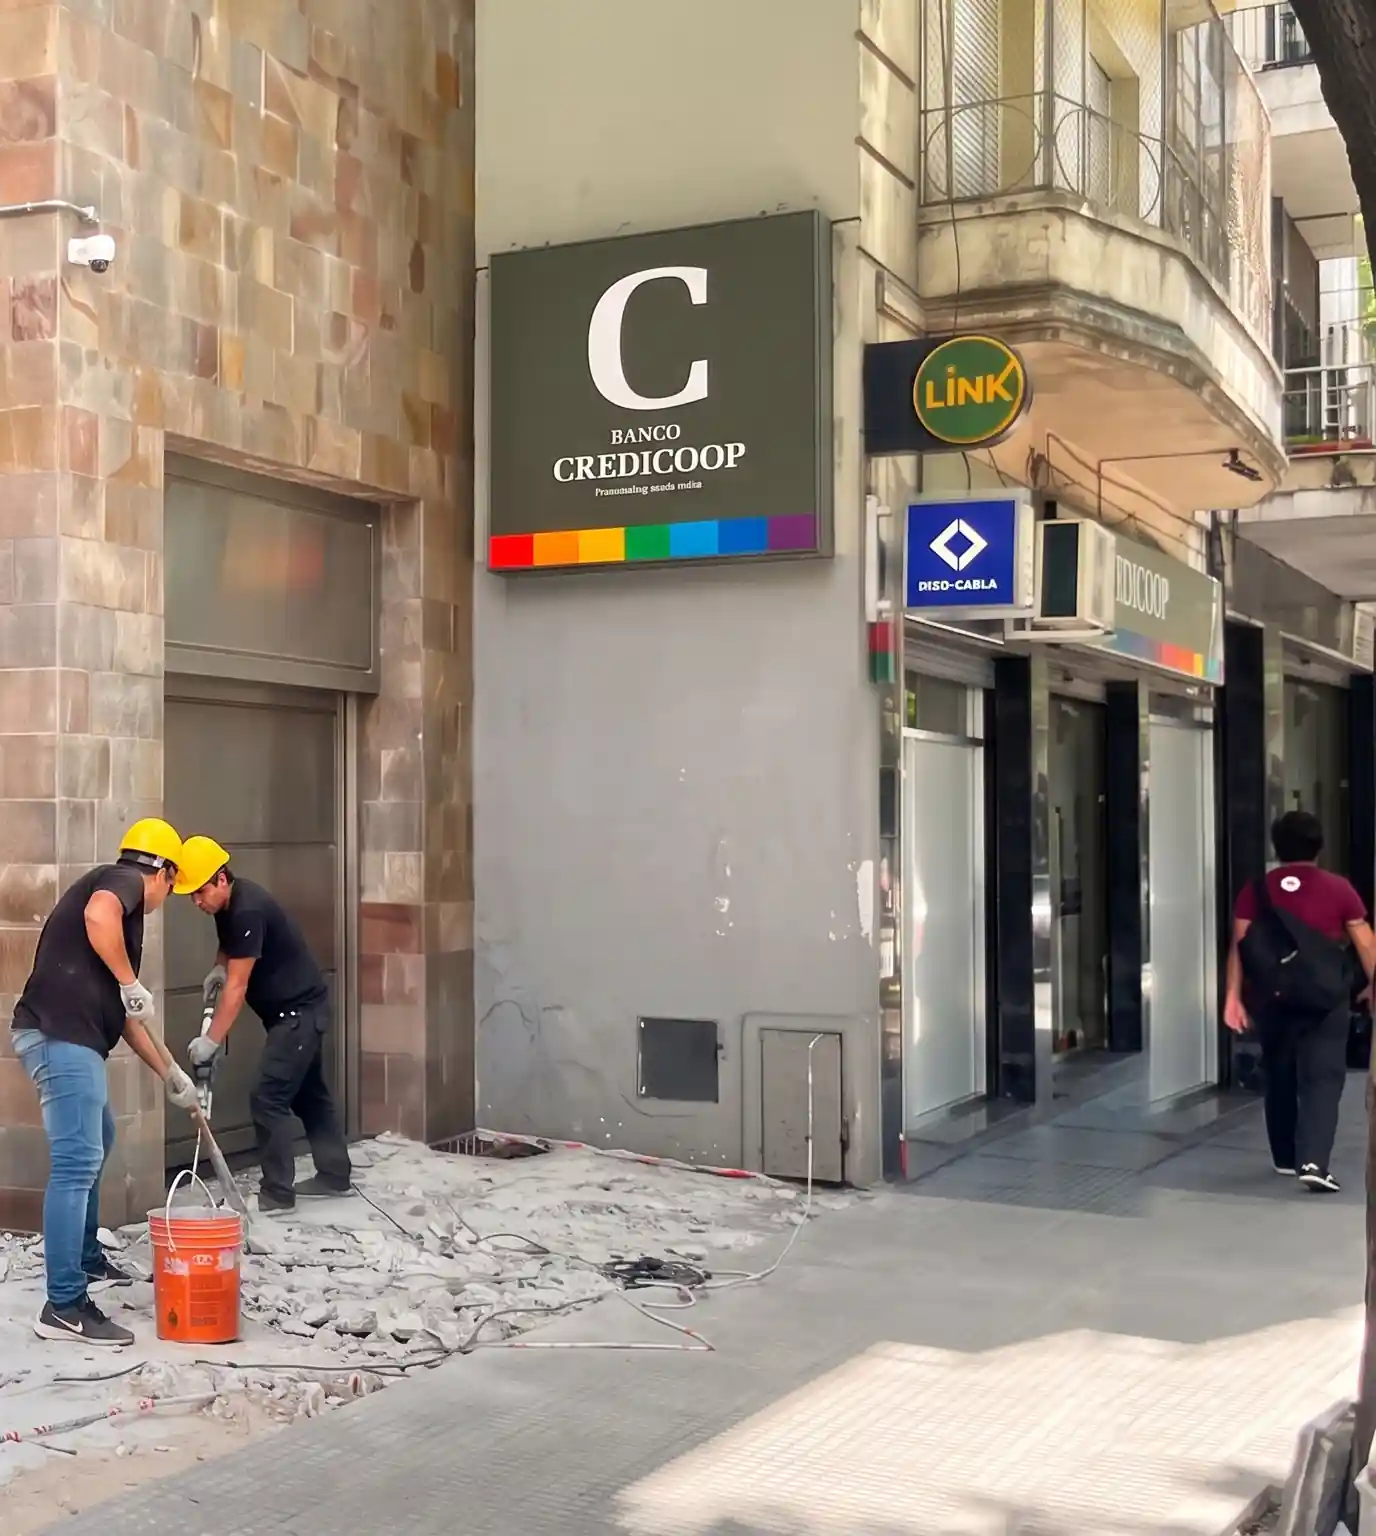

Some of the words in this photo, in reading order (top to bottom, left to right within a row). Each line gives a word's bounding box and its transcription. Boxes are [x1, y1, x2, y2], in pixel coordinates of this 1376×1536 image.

[587, 266, 709, 411] C
[610, 423, 681, 446] BANCO
[552, 441, 746, 483] CREDICOOP
